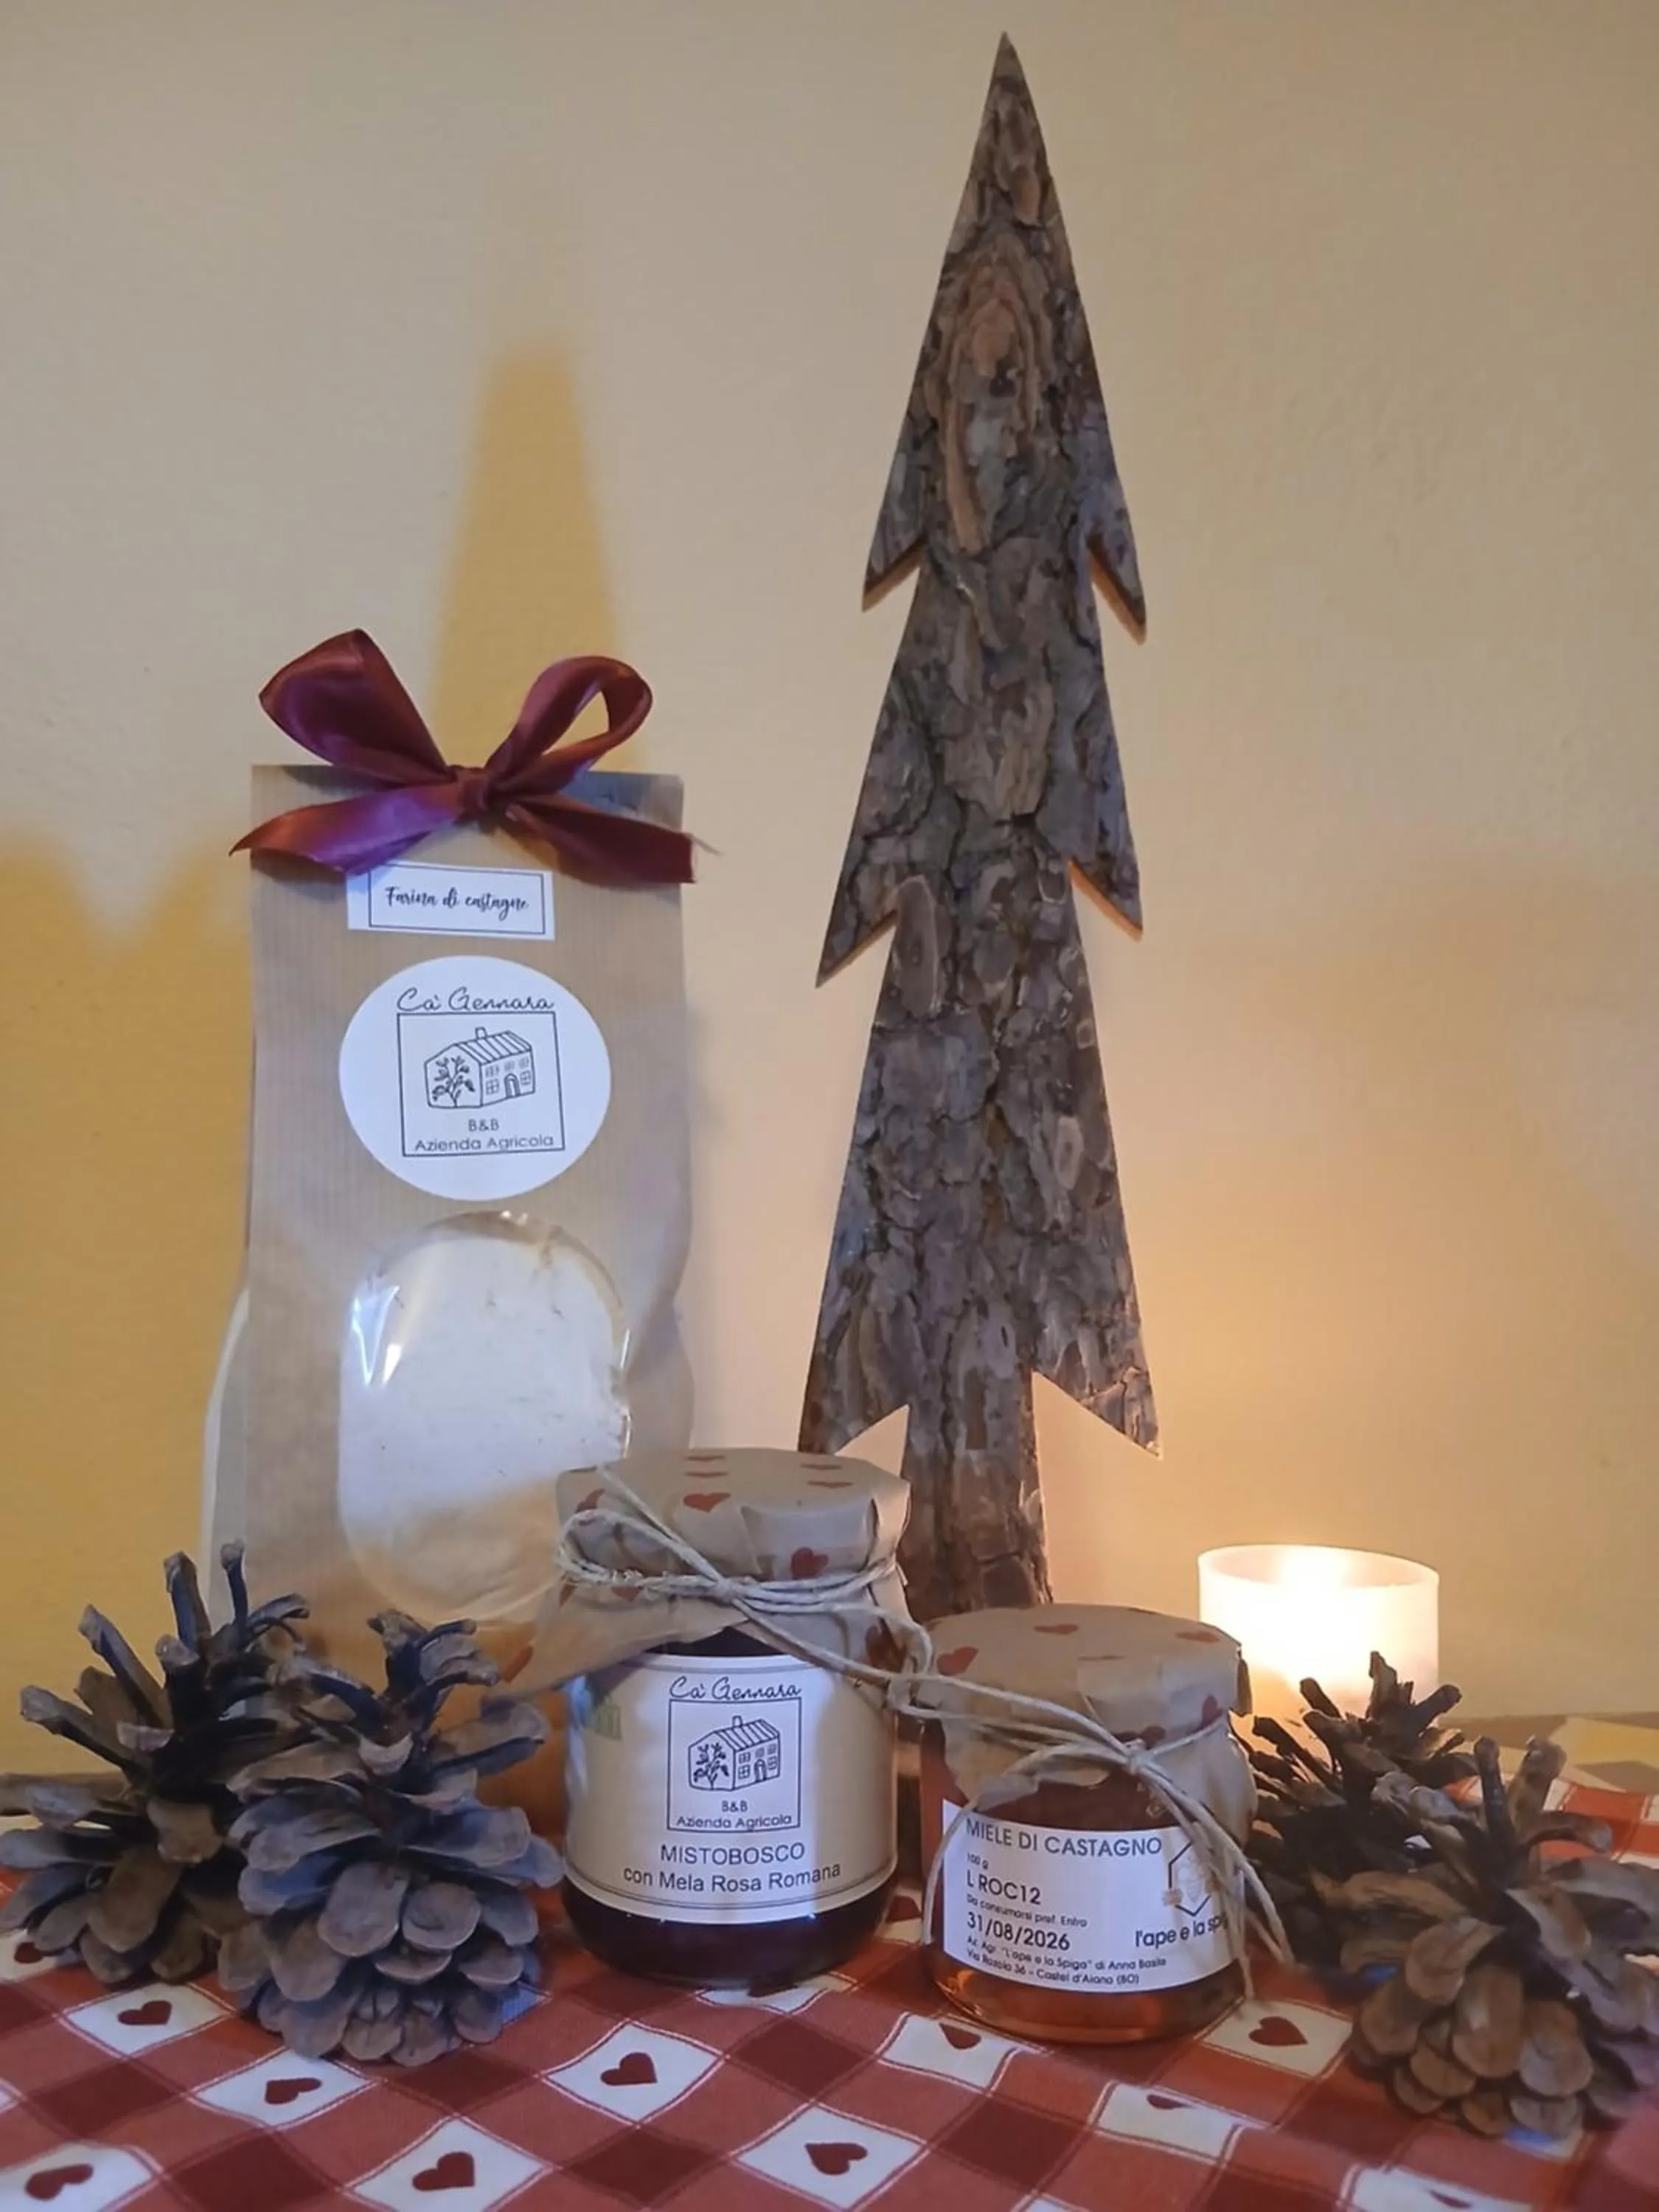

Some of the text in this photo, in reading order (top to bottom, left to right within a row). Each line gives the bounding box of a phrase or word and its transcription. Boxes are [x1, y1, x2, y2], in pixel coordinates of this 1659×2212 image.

[384, 886, 529, 921] Farina di castagne
[448, 986, 554, 1011] Gennara
[468, 1119, 499, 1132] B&B
[414, 1133, 554, 1152] Azienda Agricola
[712, 1676, 801, 1700] Gennara
[721, 1800, 748, 1812] B&B
[676, 1813, 793, 1832] Azienda Agricola
[966, 1818, 1163, 1857] MIELE DI CASTAGNO
[661, 1842, 805, 1865] MISTOBOSCO
[623, 1863, 841, 1893] con Mela Rosa Romana
[967, 1869, 1041, 1905] L ROC12
[967, 1911, 1071, 1951] 31/08/2026
[1060, 1916, 1088, 1927] Entro
[1135, 1929, 1178, 1950] l'ape
[1180, 1926, 1190, 1941] e
[1192, 1920, 1206, 1938] la
[1107, 1960, 1136, 1970] Anna
[1116, 1972, 1139, 1984] (BO)
